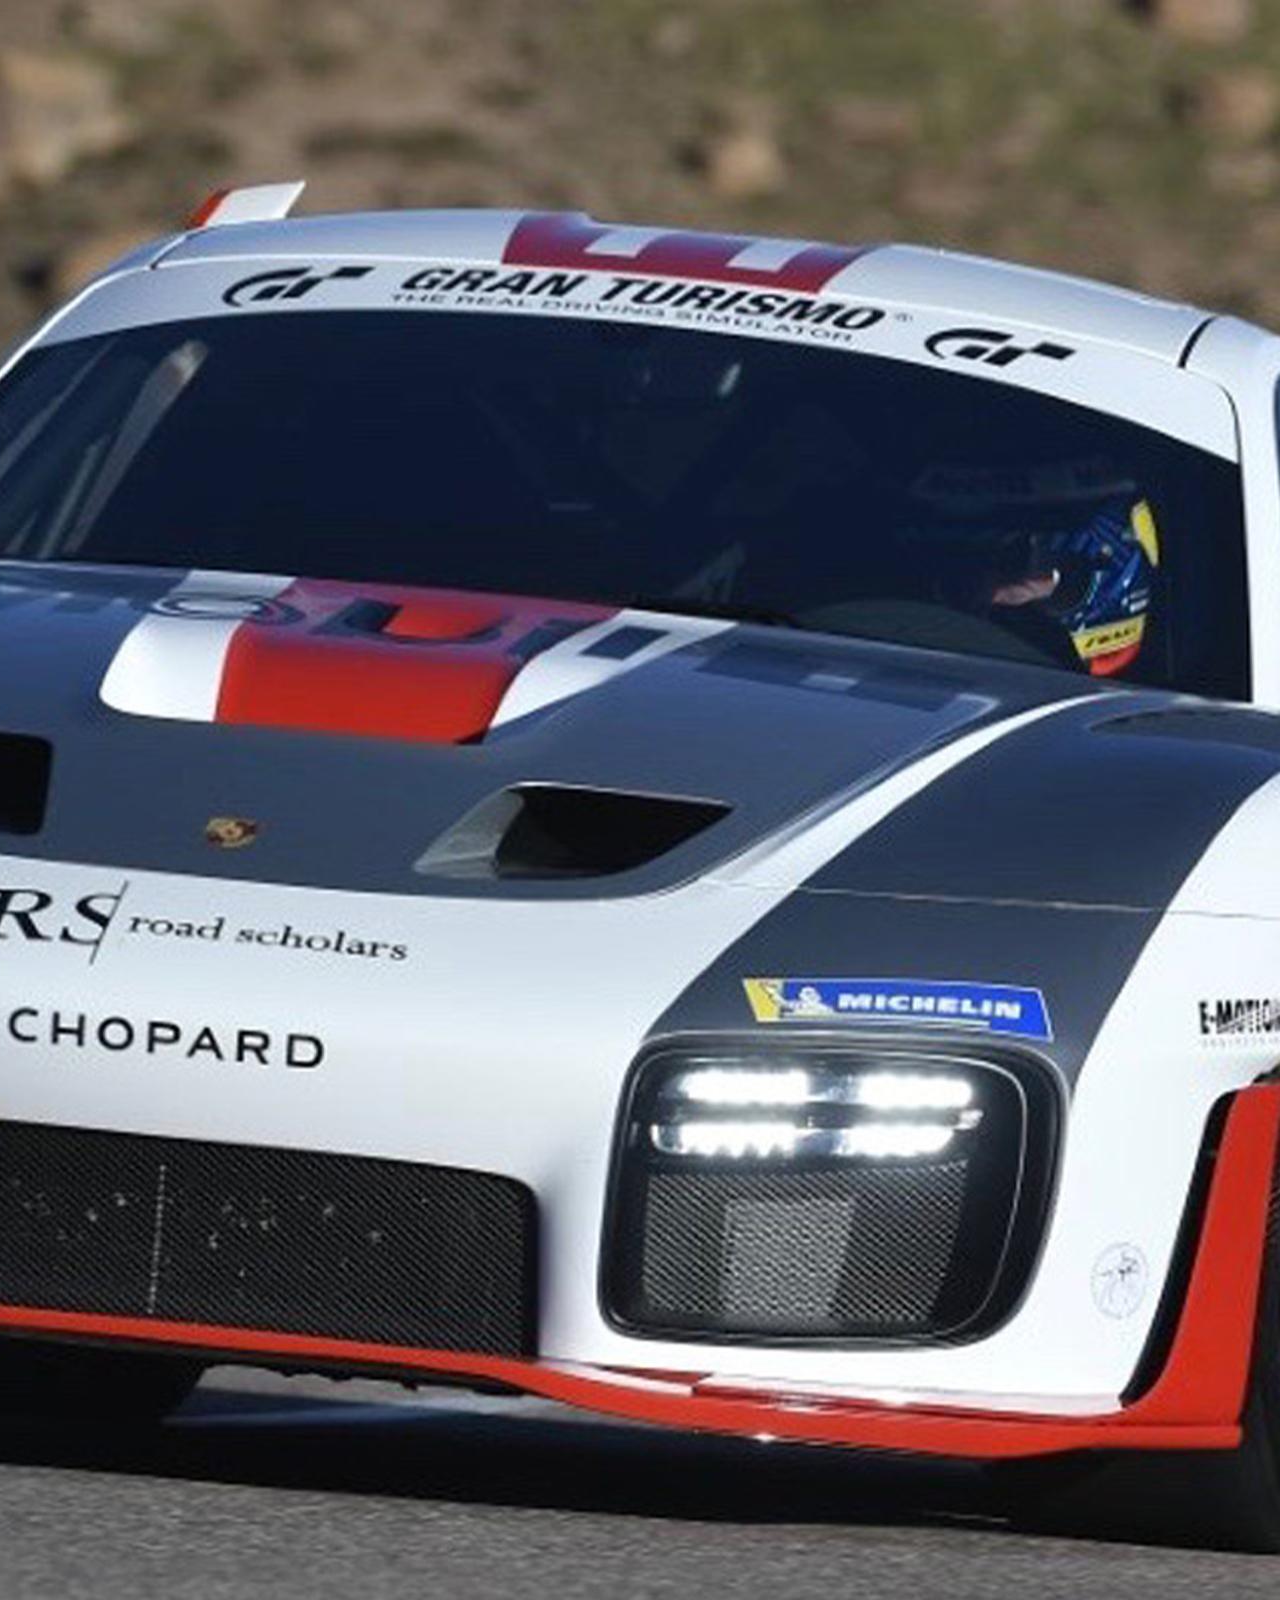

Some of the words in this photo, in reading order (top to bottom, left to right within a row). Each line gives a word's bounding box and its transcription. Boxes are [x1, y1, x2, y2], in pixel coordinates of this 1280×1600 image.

[392, 294, 446, 304] THE
[454, 296, 532, 308] REAL
[540, 300, 665, 319] DRIVING
[676, 311, 854, 343] SIMULATOR
[400, 268, 587, 297] GRAN
[600, 277, 887, 330] TURISMO
[125, 915, 225, 942] road
[235, 924, 410, 961] scholars
[836, 993, 1022, 1019] MICHELIN
[7, 1007, 325, 1069] CHOPARD
